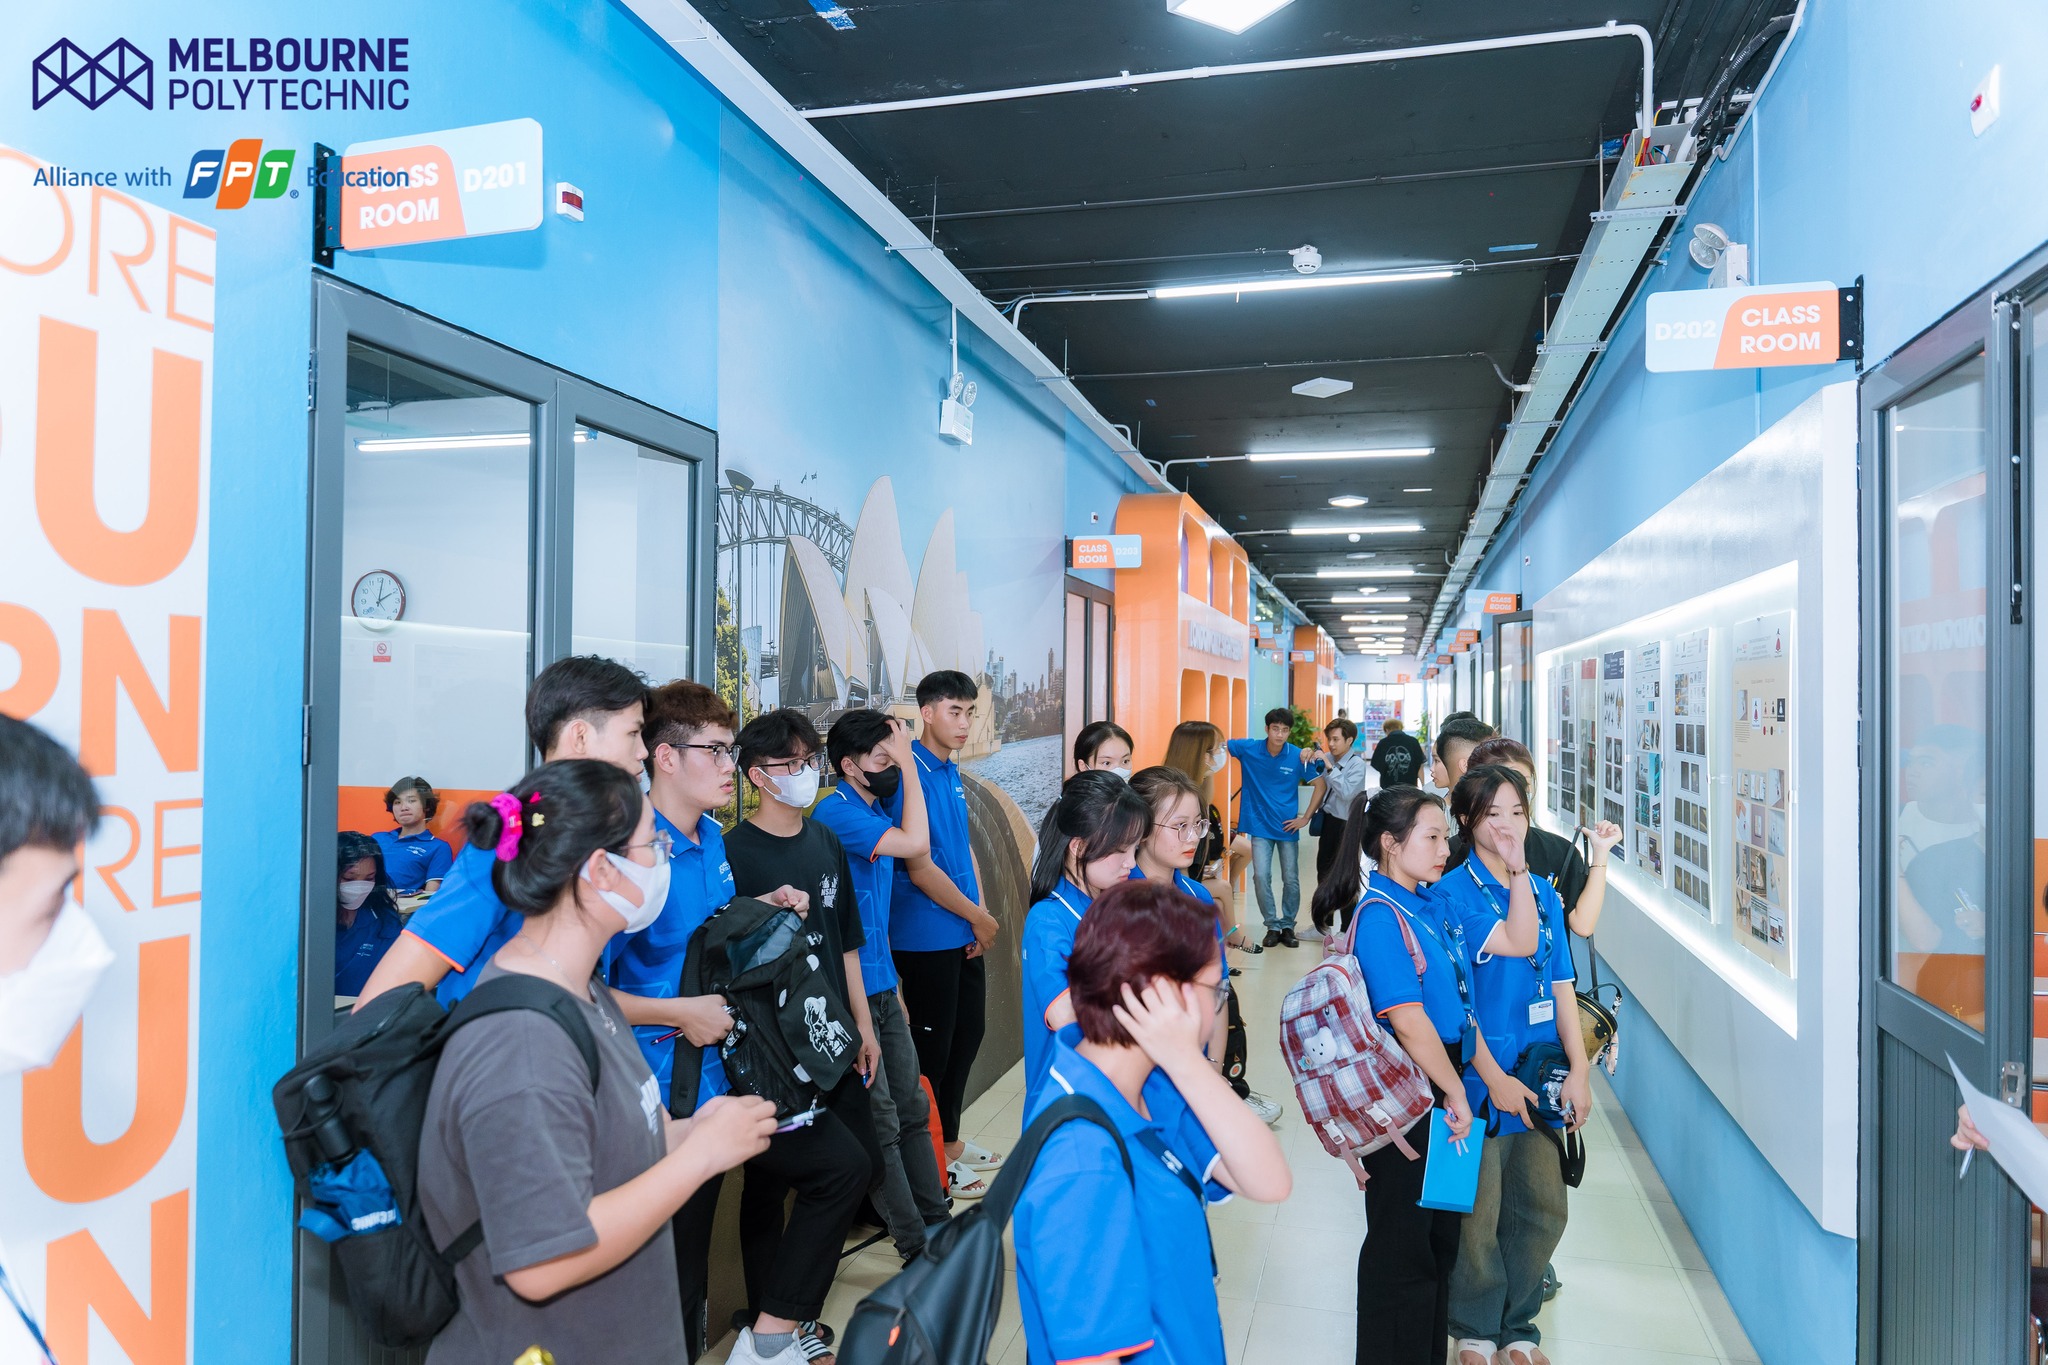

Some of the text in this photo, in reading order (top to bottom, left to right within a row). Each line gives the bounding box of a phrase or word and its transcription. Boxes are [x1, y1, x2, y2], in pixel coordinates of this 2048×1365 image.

[359, 160, 439, 196] CLASS
[463, 160, 528, 194] D201
[359, 198, 440, 231] ROOM
[1741, 304, 1821, 327] CLASS
[1655, 320, 1716, 341] D202
[1740, 331, 1821, 354] ROOM
[1078, 544, 1107, 553] CLASS
[1078, 555, 1107, 564] ROOM
[1115, 547, 1138, 555] D203
